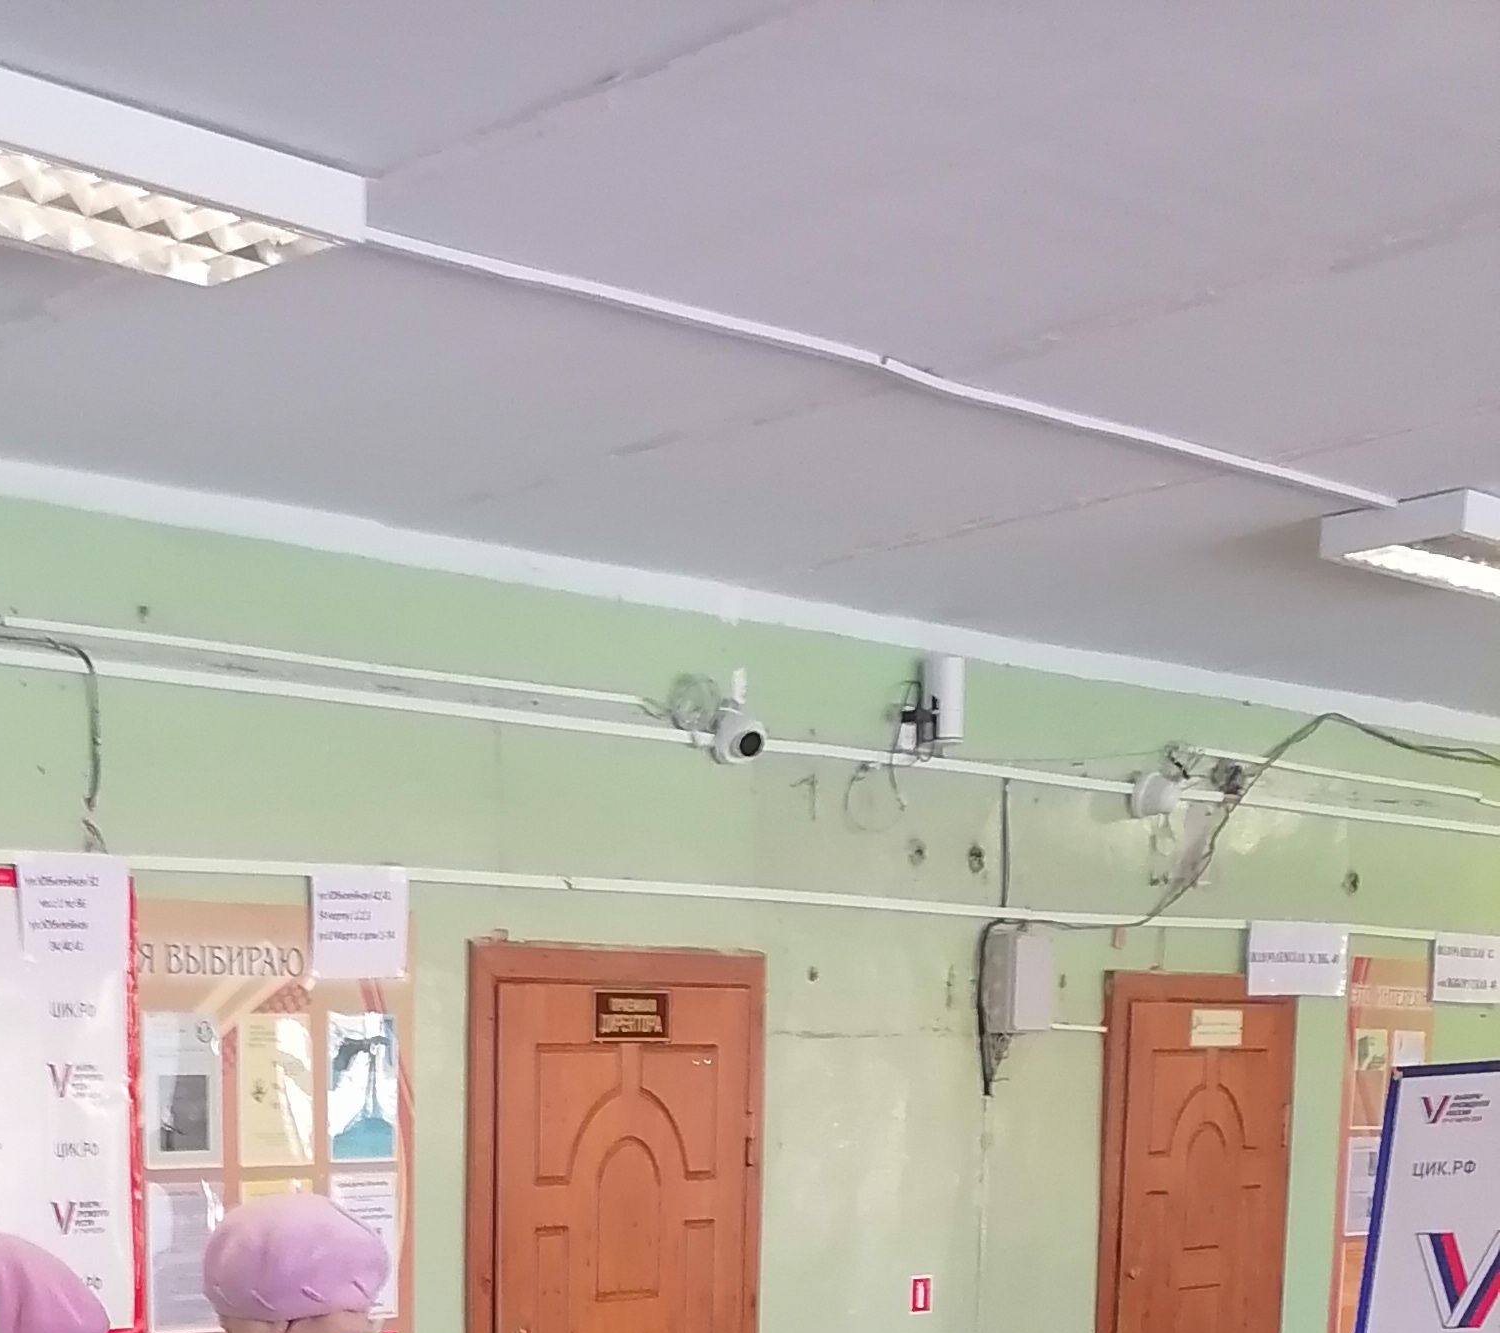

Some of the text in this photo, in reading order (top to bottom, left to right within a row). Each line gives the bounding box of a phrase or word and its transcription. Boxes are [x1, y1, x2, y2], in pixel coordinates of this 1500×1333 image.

[137, 943, 305, 977] Я ВЫБИРАЮ
[1412, 1160, 1477, 1178] ЦИК.РФ
